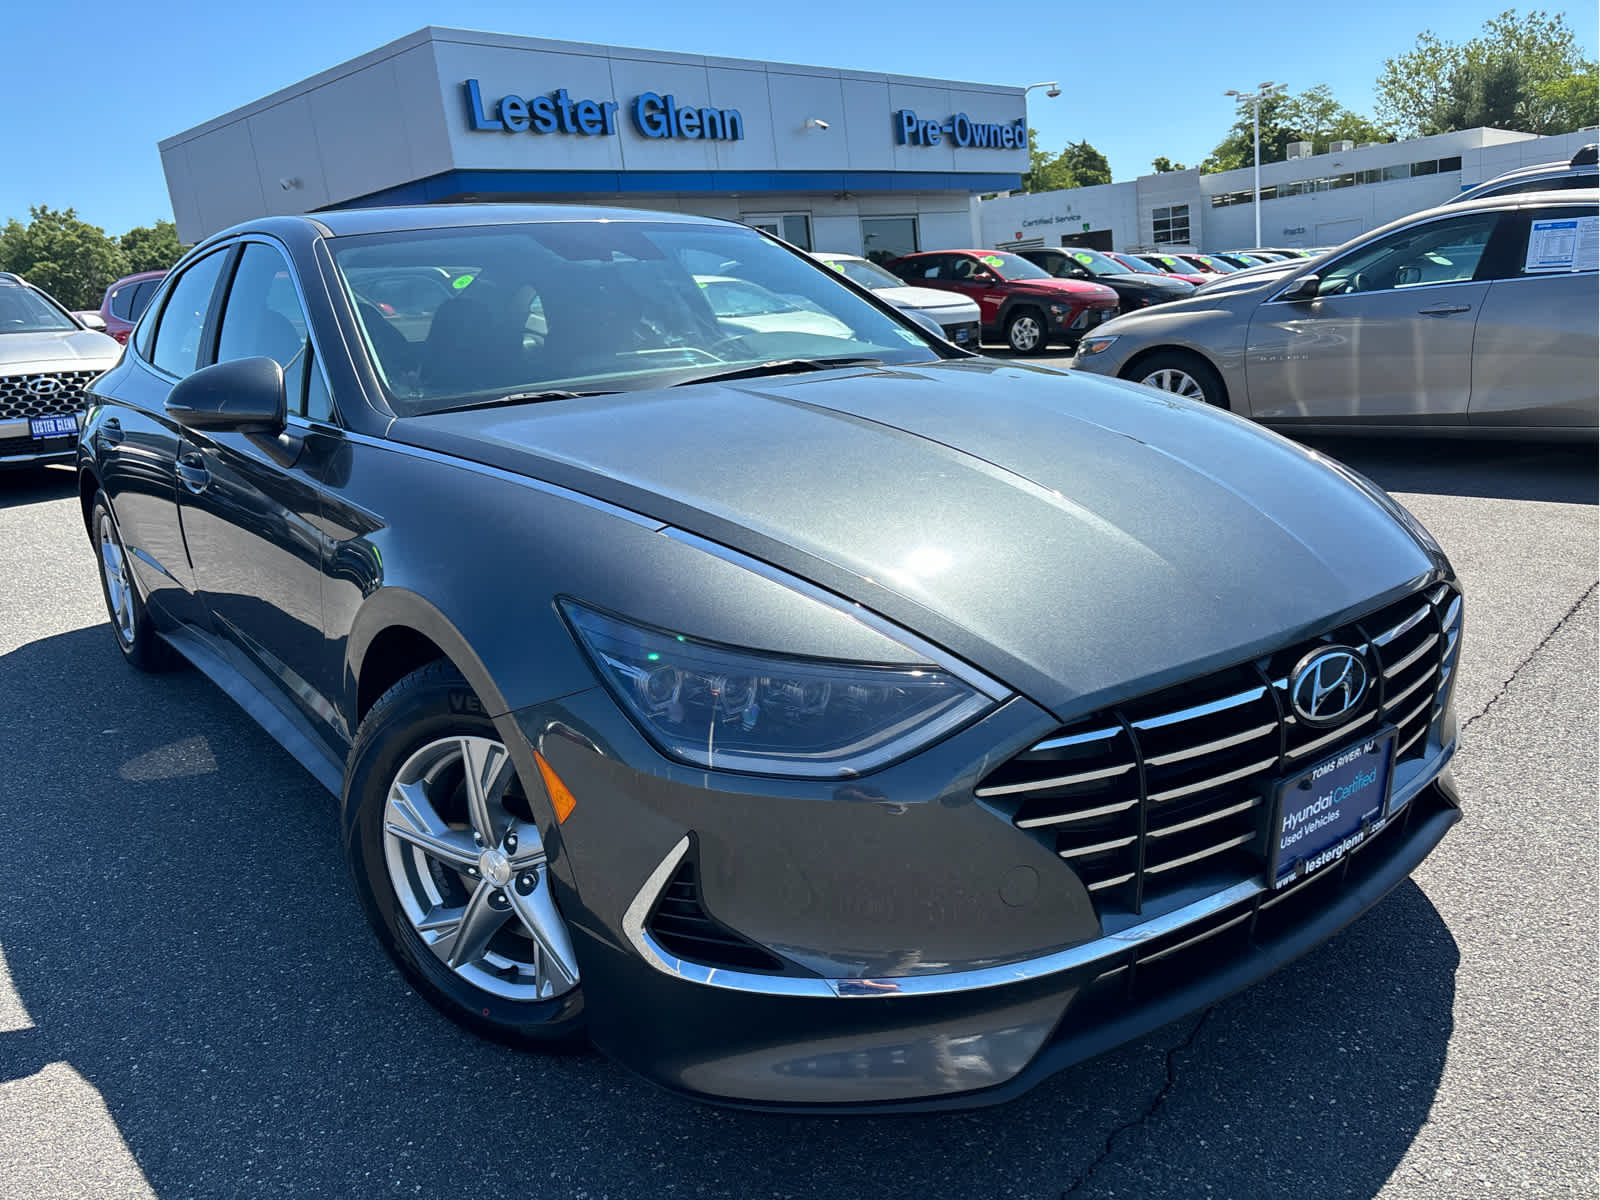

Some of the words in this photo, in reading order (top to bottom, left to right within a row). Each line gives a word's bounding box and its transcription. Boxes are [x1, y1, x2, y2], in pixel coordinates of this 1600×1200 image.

[463, 78, 618, 136] Lester
[631, 91, 745, 141] Glenn
[896, 109, 1027, 149] Pre-Owned
[1022, 217, 1053, 228] Certified
[1055, 215, 1082, 224] Service
[31, 419, 56, 434] LESTER
[56, 416, 77, 432] GLENN
[1312, 760, 1336, 780] TOMS
[1363, 740, 1375, 754] NJ
[1282, 791, 1333, 832] Hyundai
[1333, 768, 1377, 803] Certified
[1280, 830, 1303, 849] Used
[1304, 809, 1340, 835] Vehicles
[1276, 872, 1297, 890] www.
[1305, 832, 1364, 874] lesterglenn
